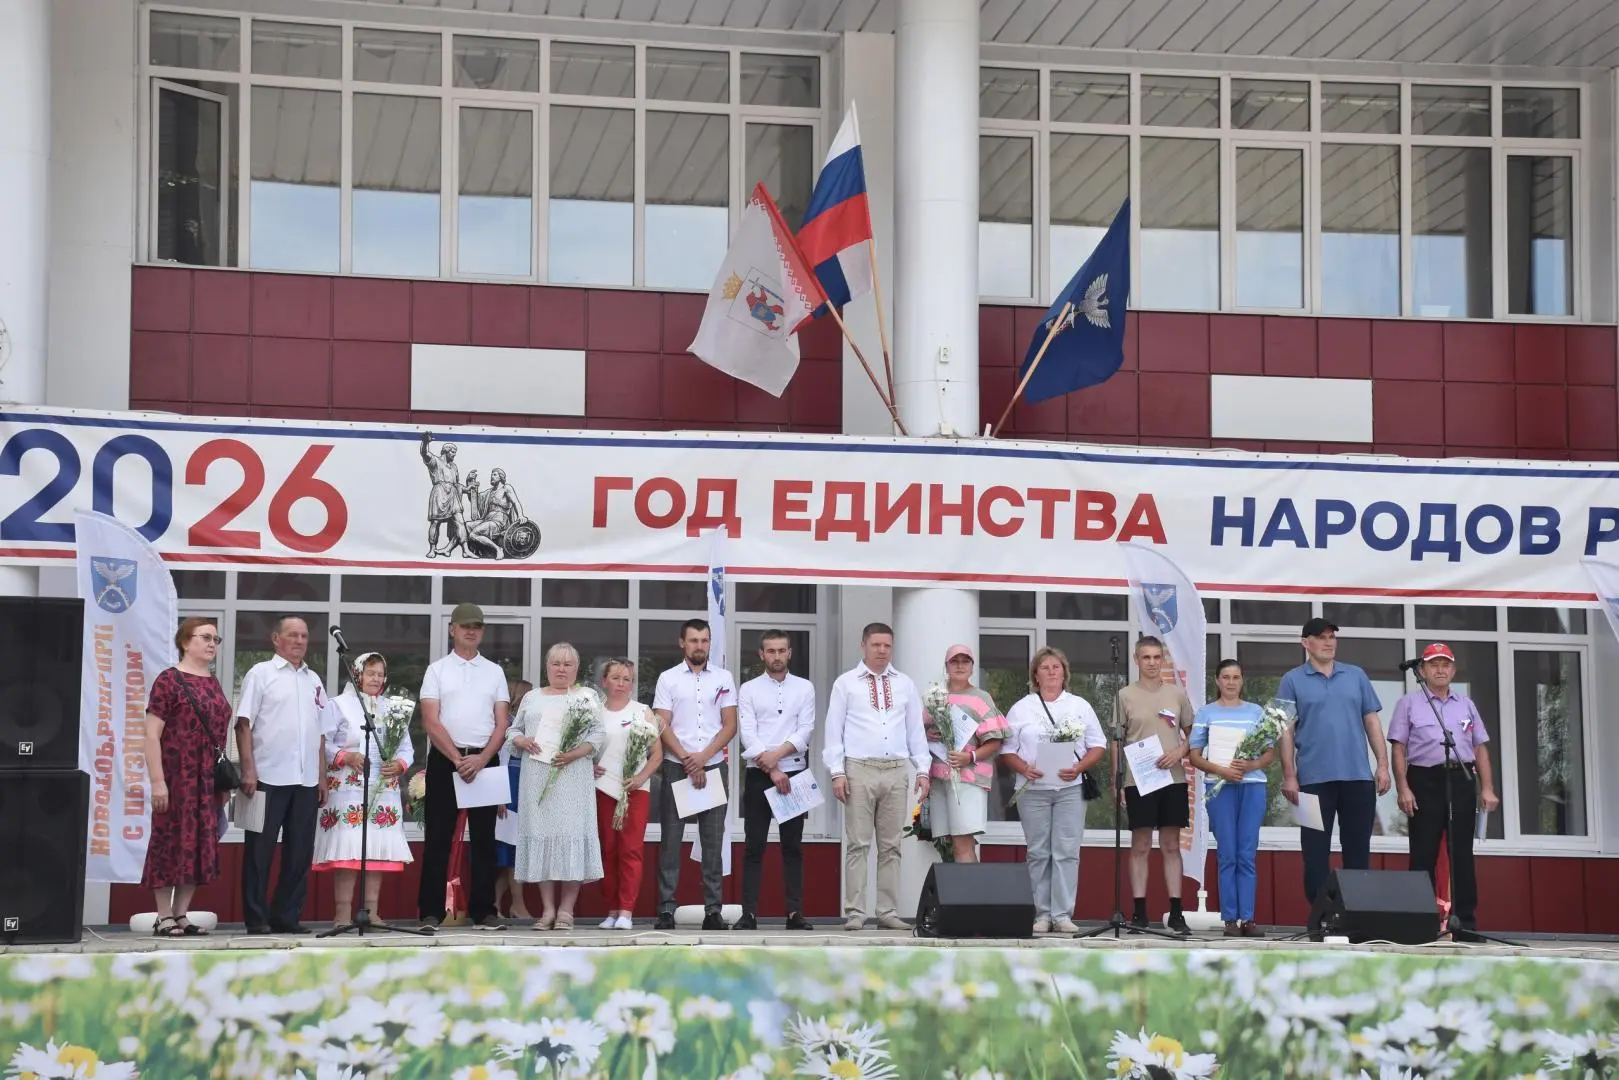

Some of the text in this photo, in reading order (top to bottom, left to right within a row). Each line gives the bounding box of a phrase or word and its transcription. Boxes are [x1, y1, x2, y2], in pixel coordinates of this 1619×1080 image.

[0, 428, 348, 553] 2026
[593, 476, 741, 538] ГОД
[772, 480, 1167, 544] ЕДИНСТВА
[1211, 496, 1561, 562] НАРОДОВ
